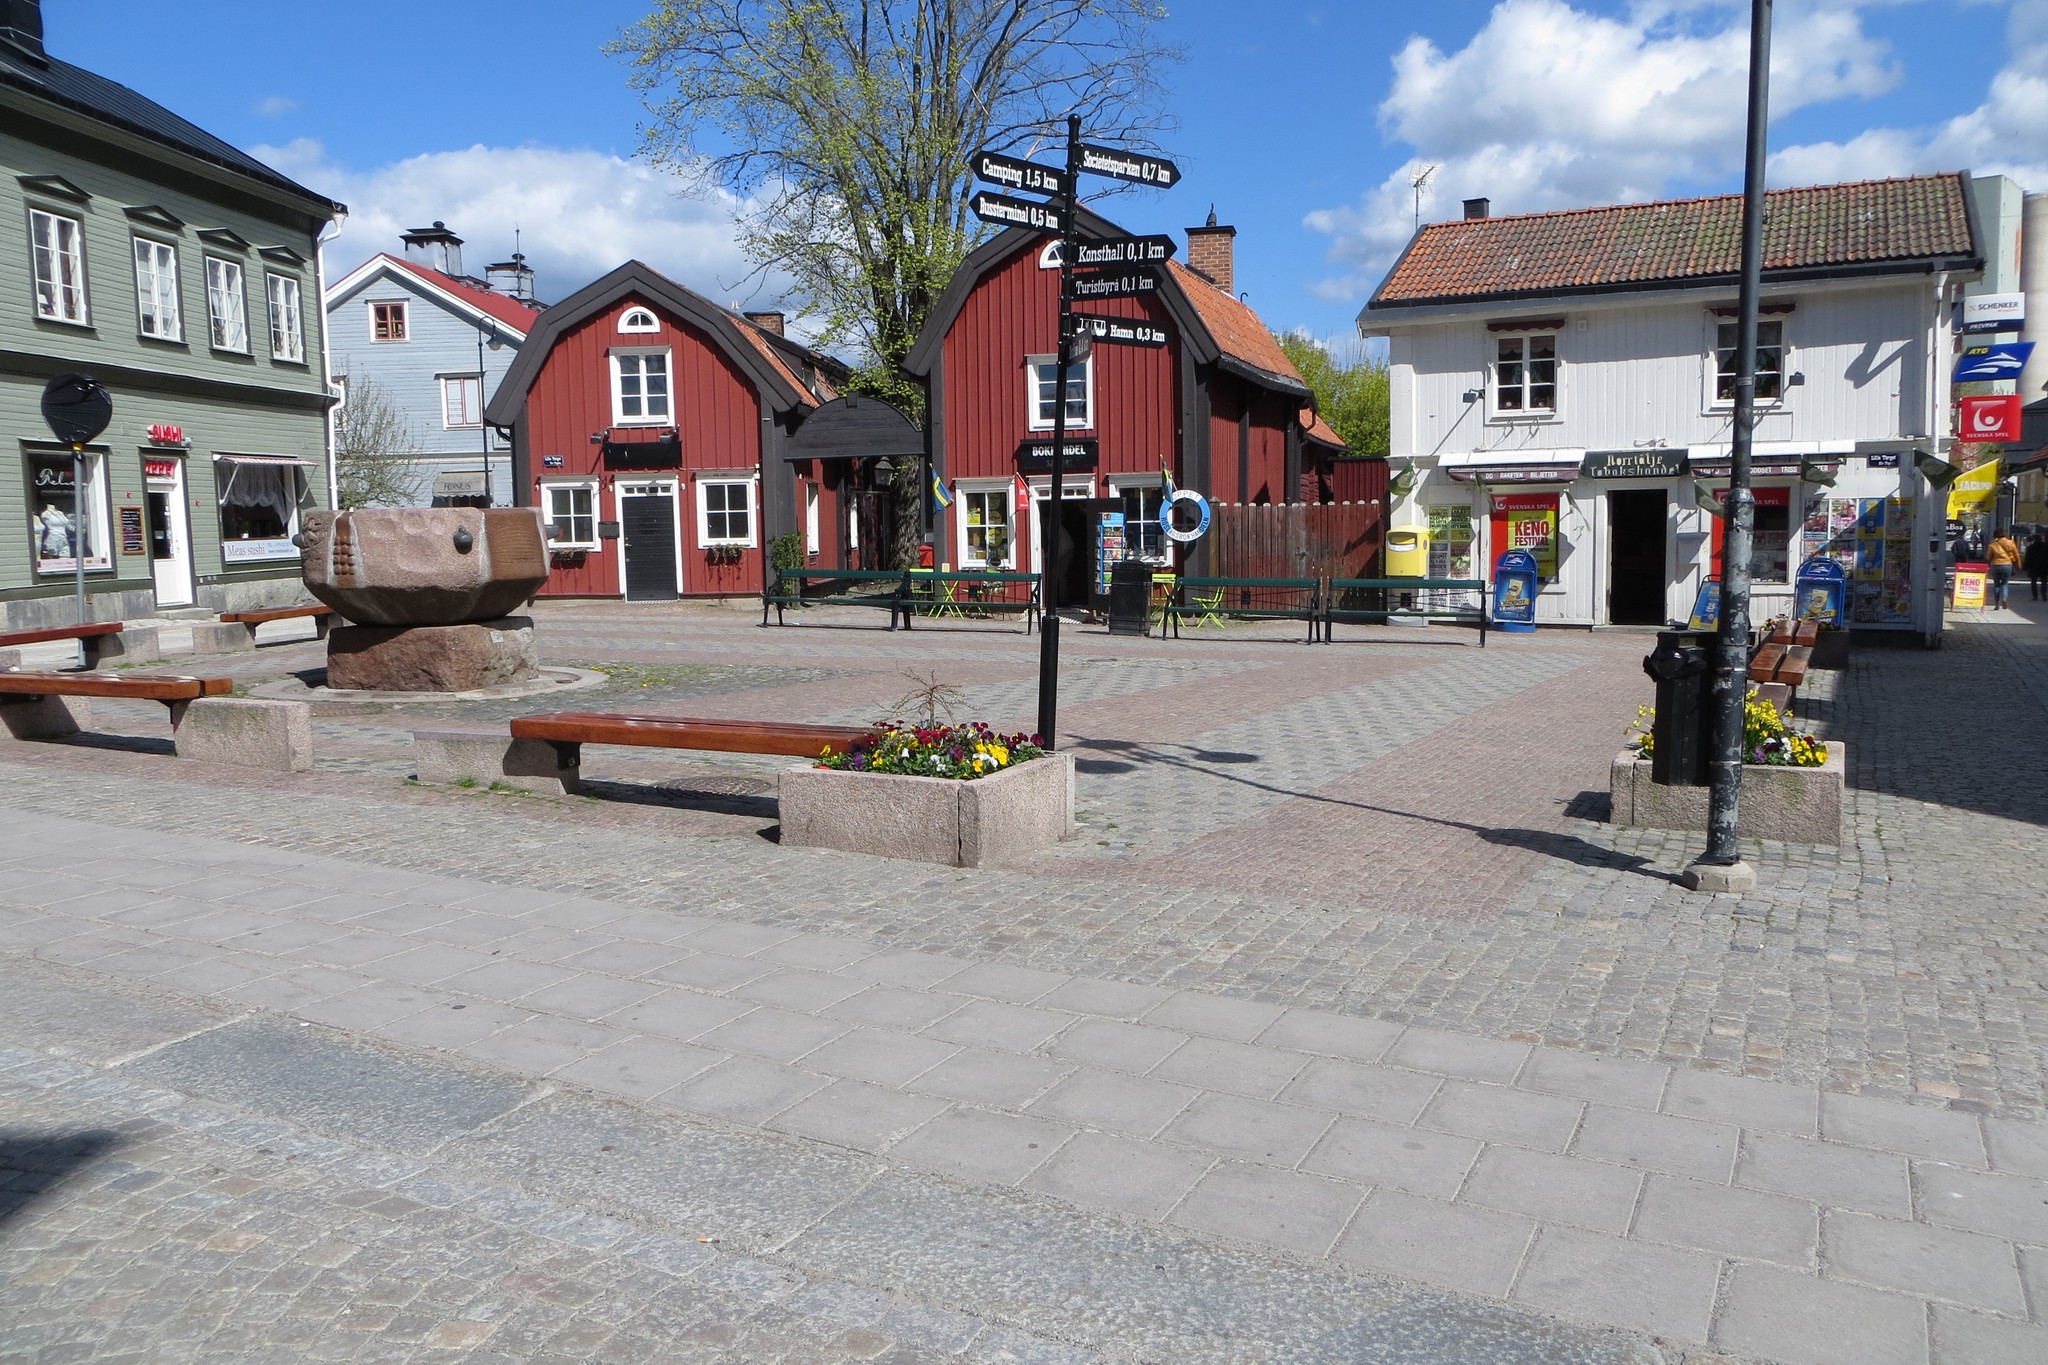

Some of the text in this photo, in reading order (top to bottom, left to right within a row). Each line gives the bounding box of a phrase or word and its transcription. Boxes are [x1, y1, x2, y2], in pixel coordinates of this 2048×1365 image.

[1083, 150, 1171, 183] Societetsparken 0,7 km
[982, 158, 1058, 191] Camping 1,5 km
[979, 196, 1058, 229] Bussterminal 0,5 km
[1078, 241, 1165, 263] Konsthall 0,1 km
[1075, 275, 1154, 295] Turistbyrå 0,1 km
[1977, 301, 2019, 311] SCHENKER
[1110, 324, 1165, 342] Hamn 0,3 km
[1969, 321, 1999, 330] PRIVPAK
[1968, 347, 1989, 355] ATG
[149, 424, 183, 442] SUSHI
[1032, 445, 1086, 457] BOKNDEL
[444, 481, 472, 490] FONUS
[1514, 520, 1550, 536] KENO
[1514, 537, 1550, 546] FESTIVAL
[227, 544, 247, 557] Meas
[247, 543, 266, 556] sushi
[1960, 578, 1981, 587] KENO
